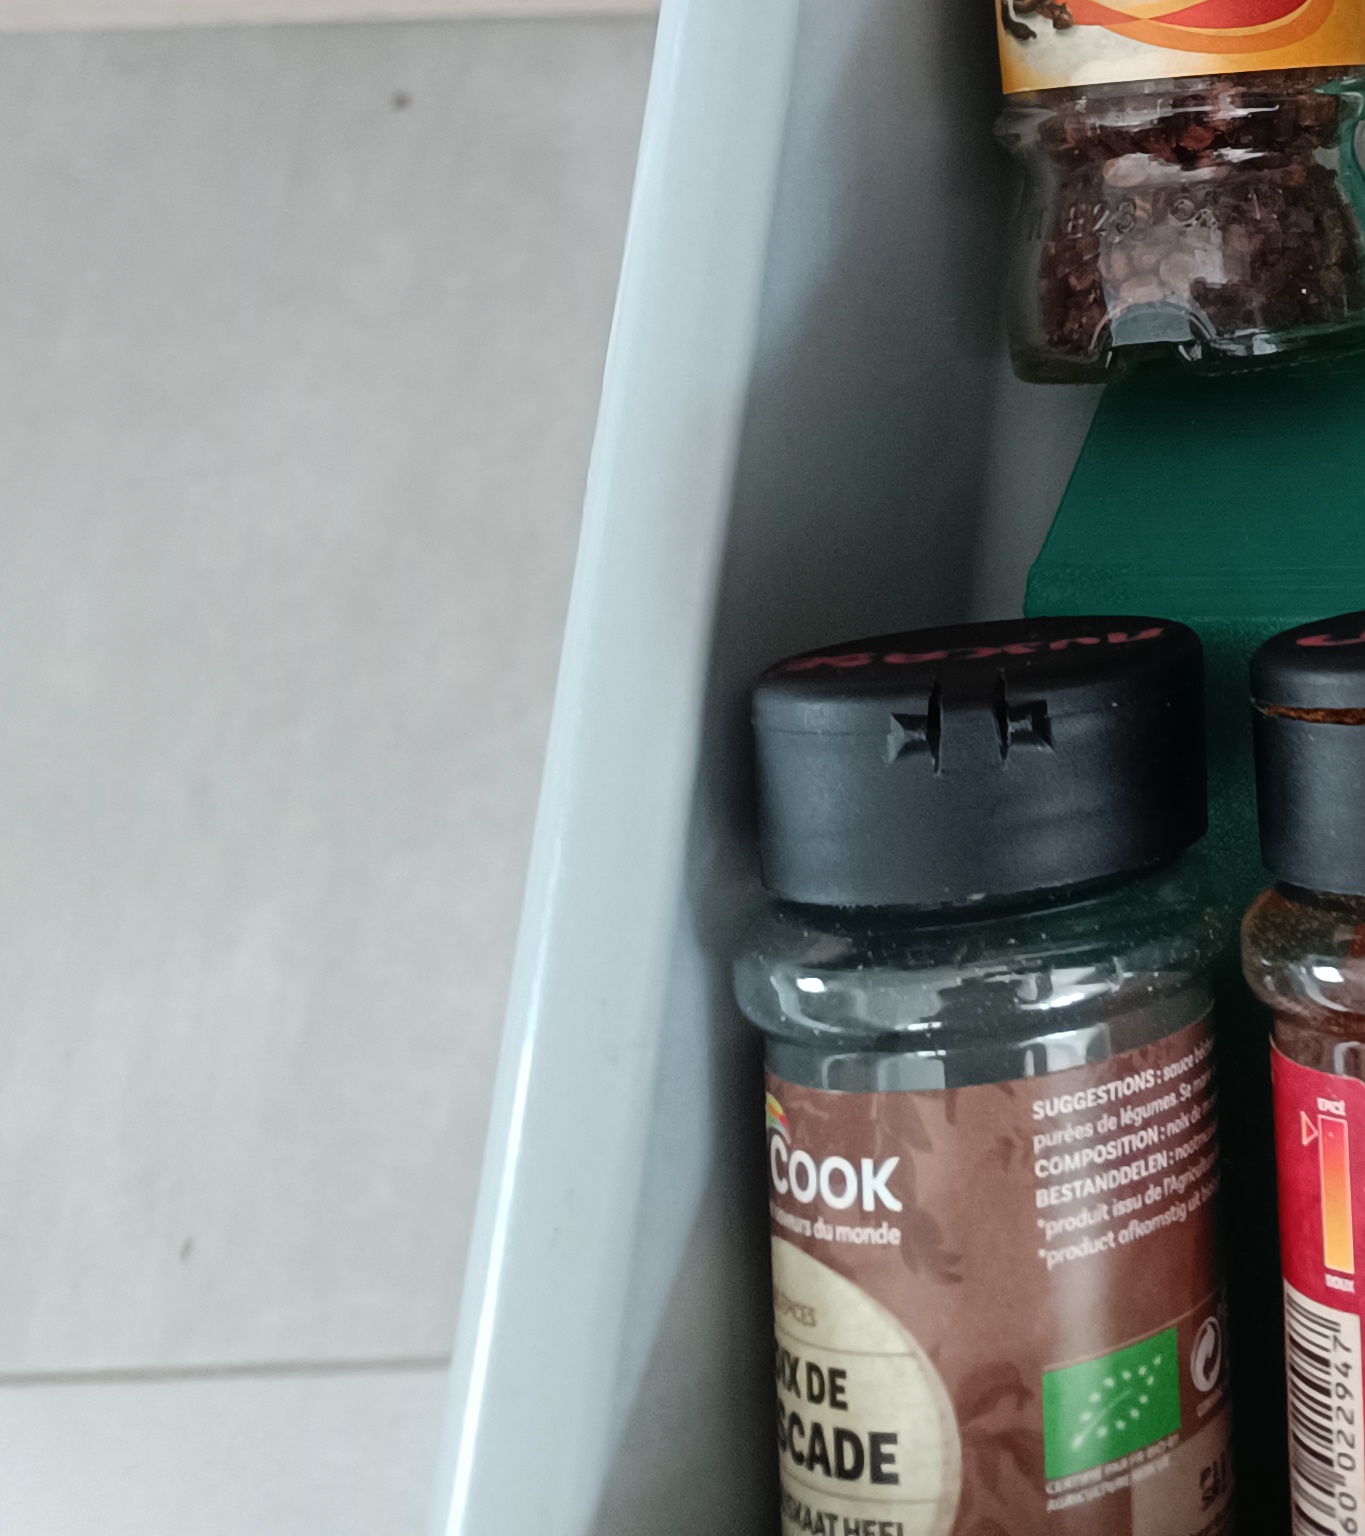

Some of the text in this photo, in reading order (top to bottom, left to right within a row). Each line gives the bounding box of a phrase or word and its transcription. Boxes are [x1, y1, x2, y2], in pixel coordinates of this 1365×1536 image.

[1032, 1069, 1156, 1121] SUGGESTIONS
[1033, 1119, 1095, 1154] purées
[1034, 1130, 1161, 1178] COMPOSITION
[770, 1133, 903, 1213] COOK
[1036, 1149, 1170, 1209] BESTANDDELEN
[806, 1361, 848, 1412] DE
